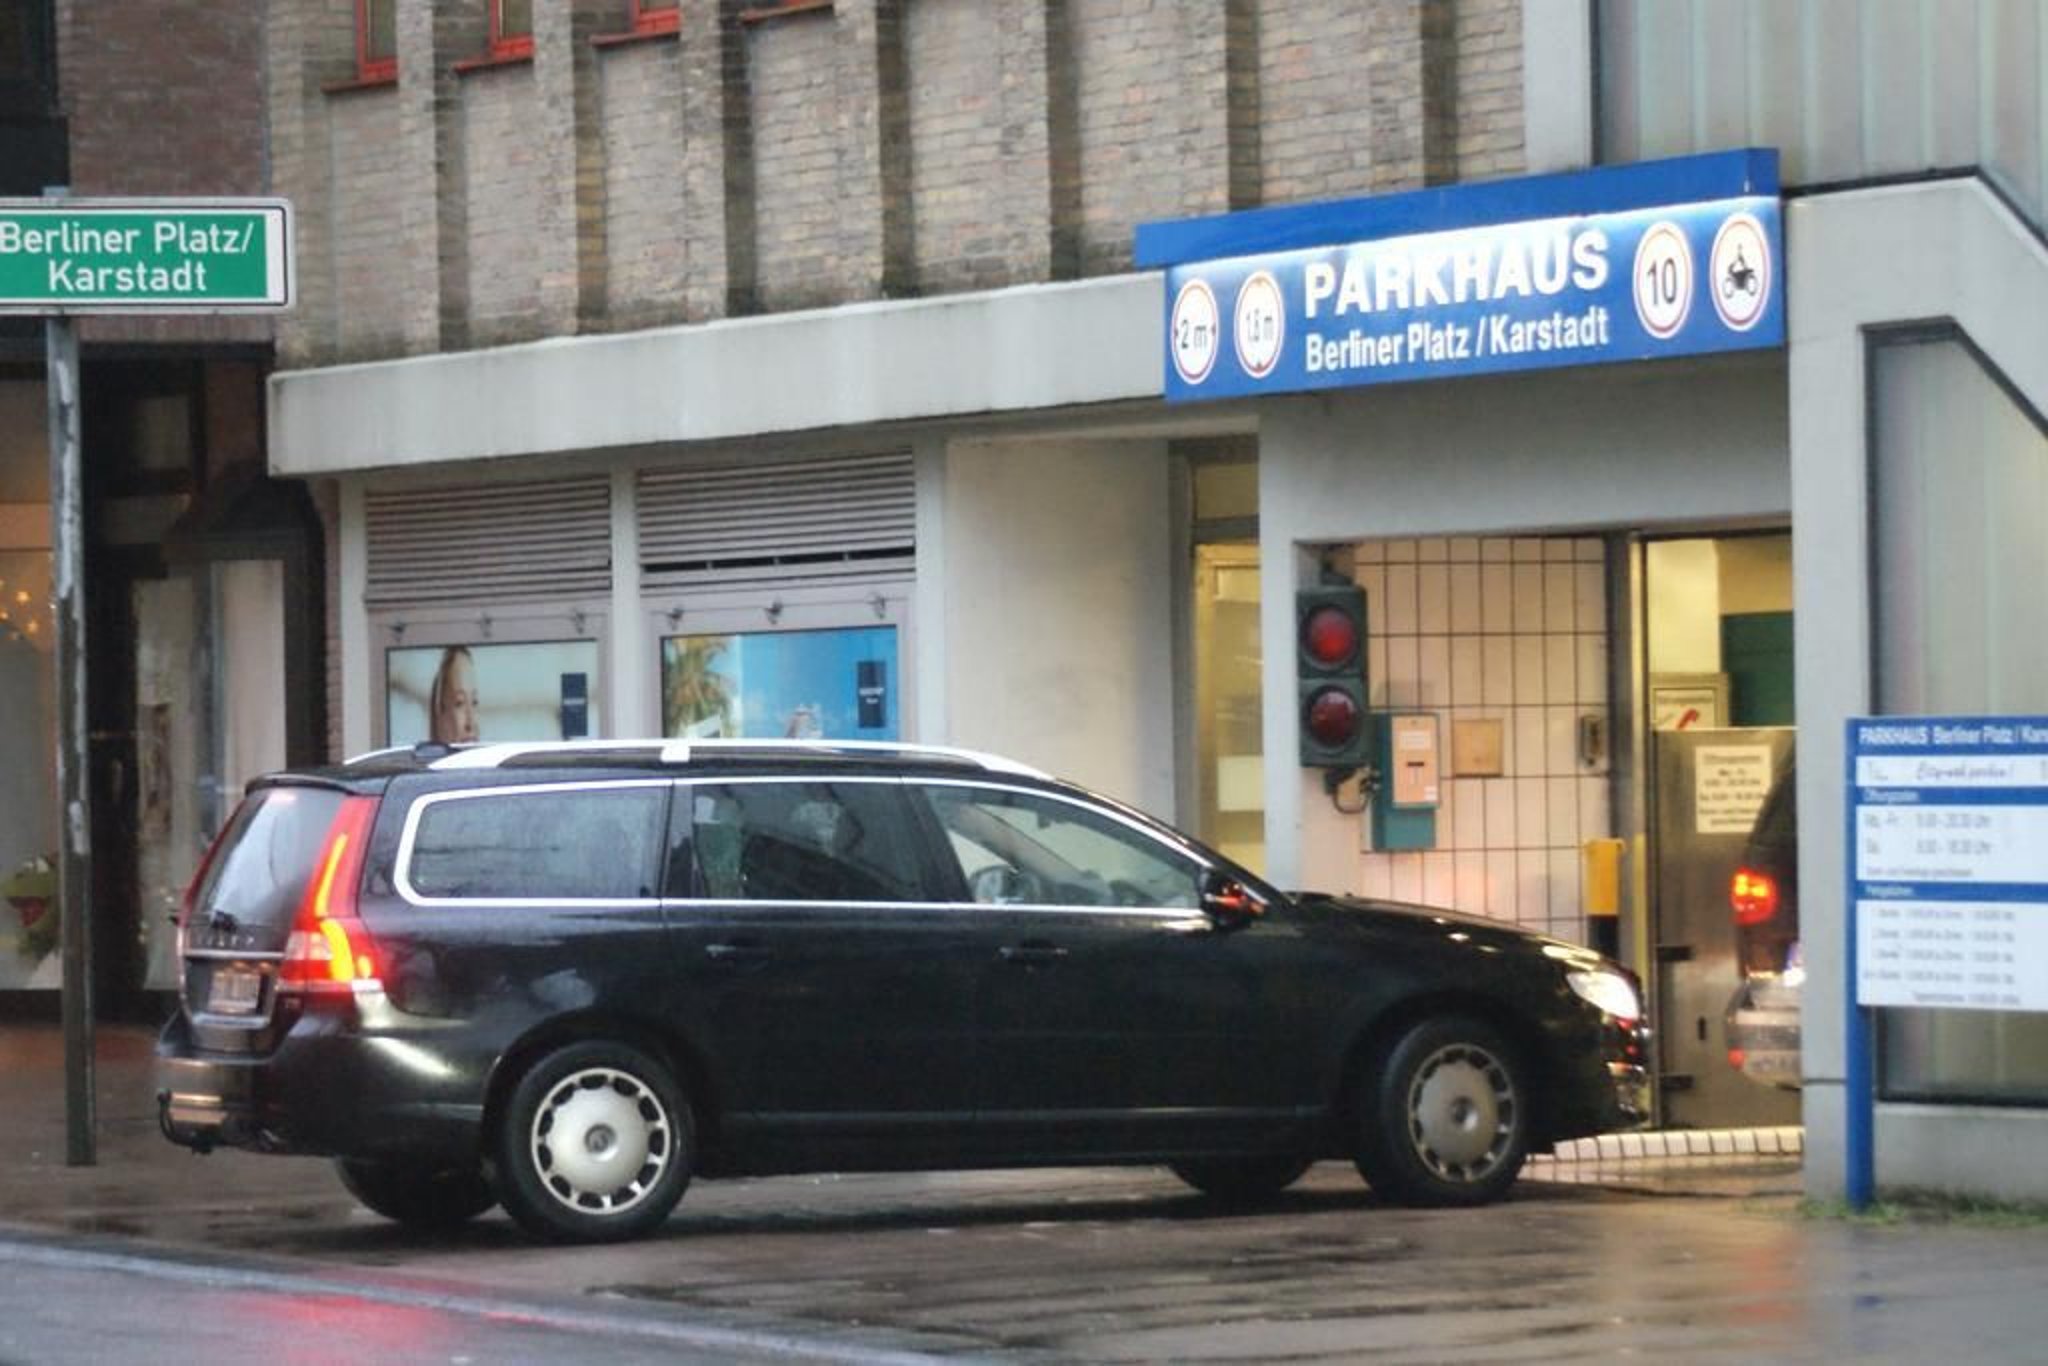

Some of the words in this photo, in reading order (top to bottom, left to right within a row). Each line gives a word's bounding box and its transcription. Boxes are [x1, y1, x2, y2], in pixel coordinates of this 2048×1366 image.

[0, 221, 140, 253] Berliner
[49, 260, 207, 292] Karstadt
[1304, 229, 1609, 319] PARKHAUS
[1648, 257, 1677, 306] 10
[1305, 329, 1404, 373] Berliner
[1407, 320, 1470, 363] Platz
[1489, 304, 1609, 354] Karstadt
